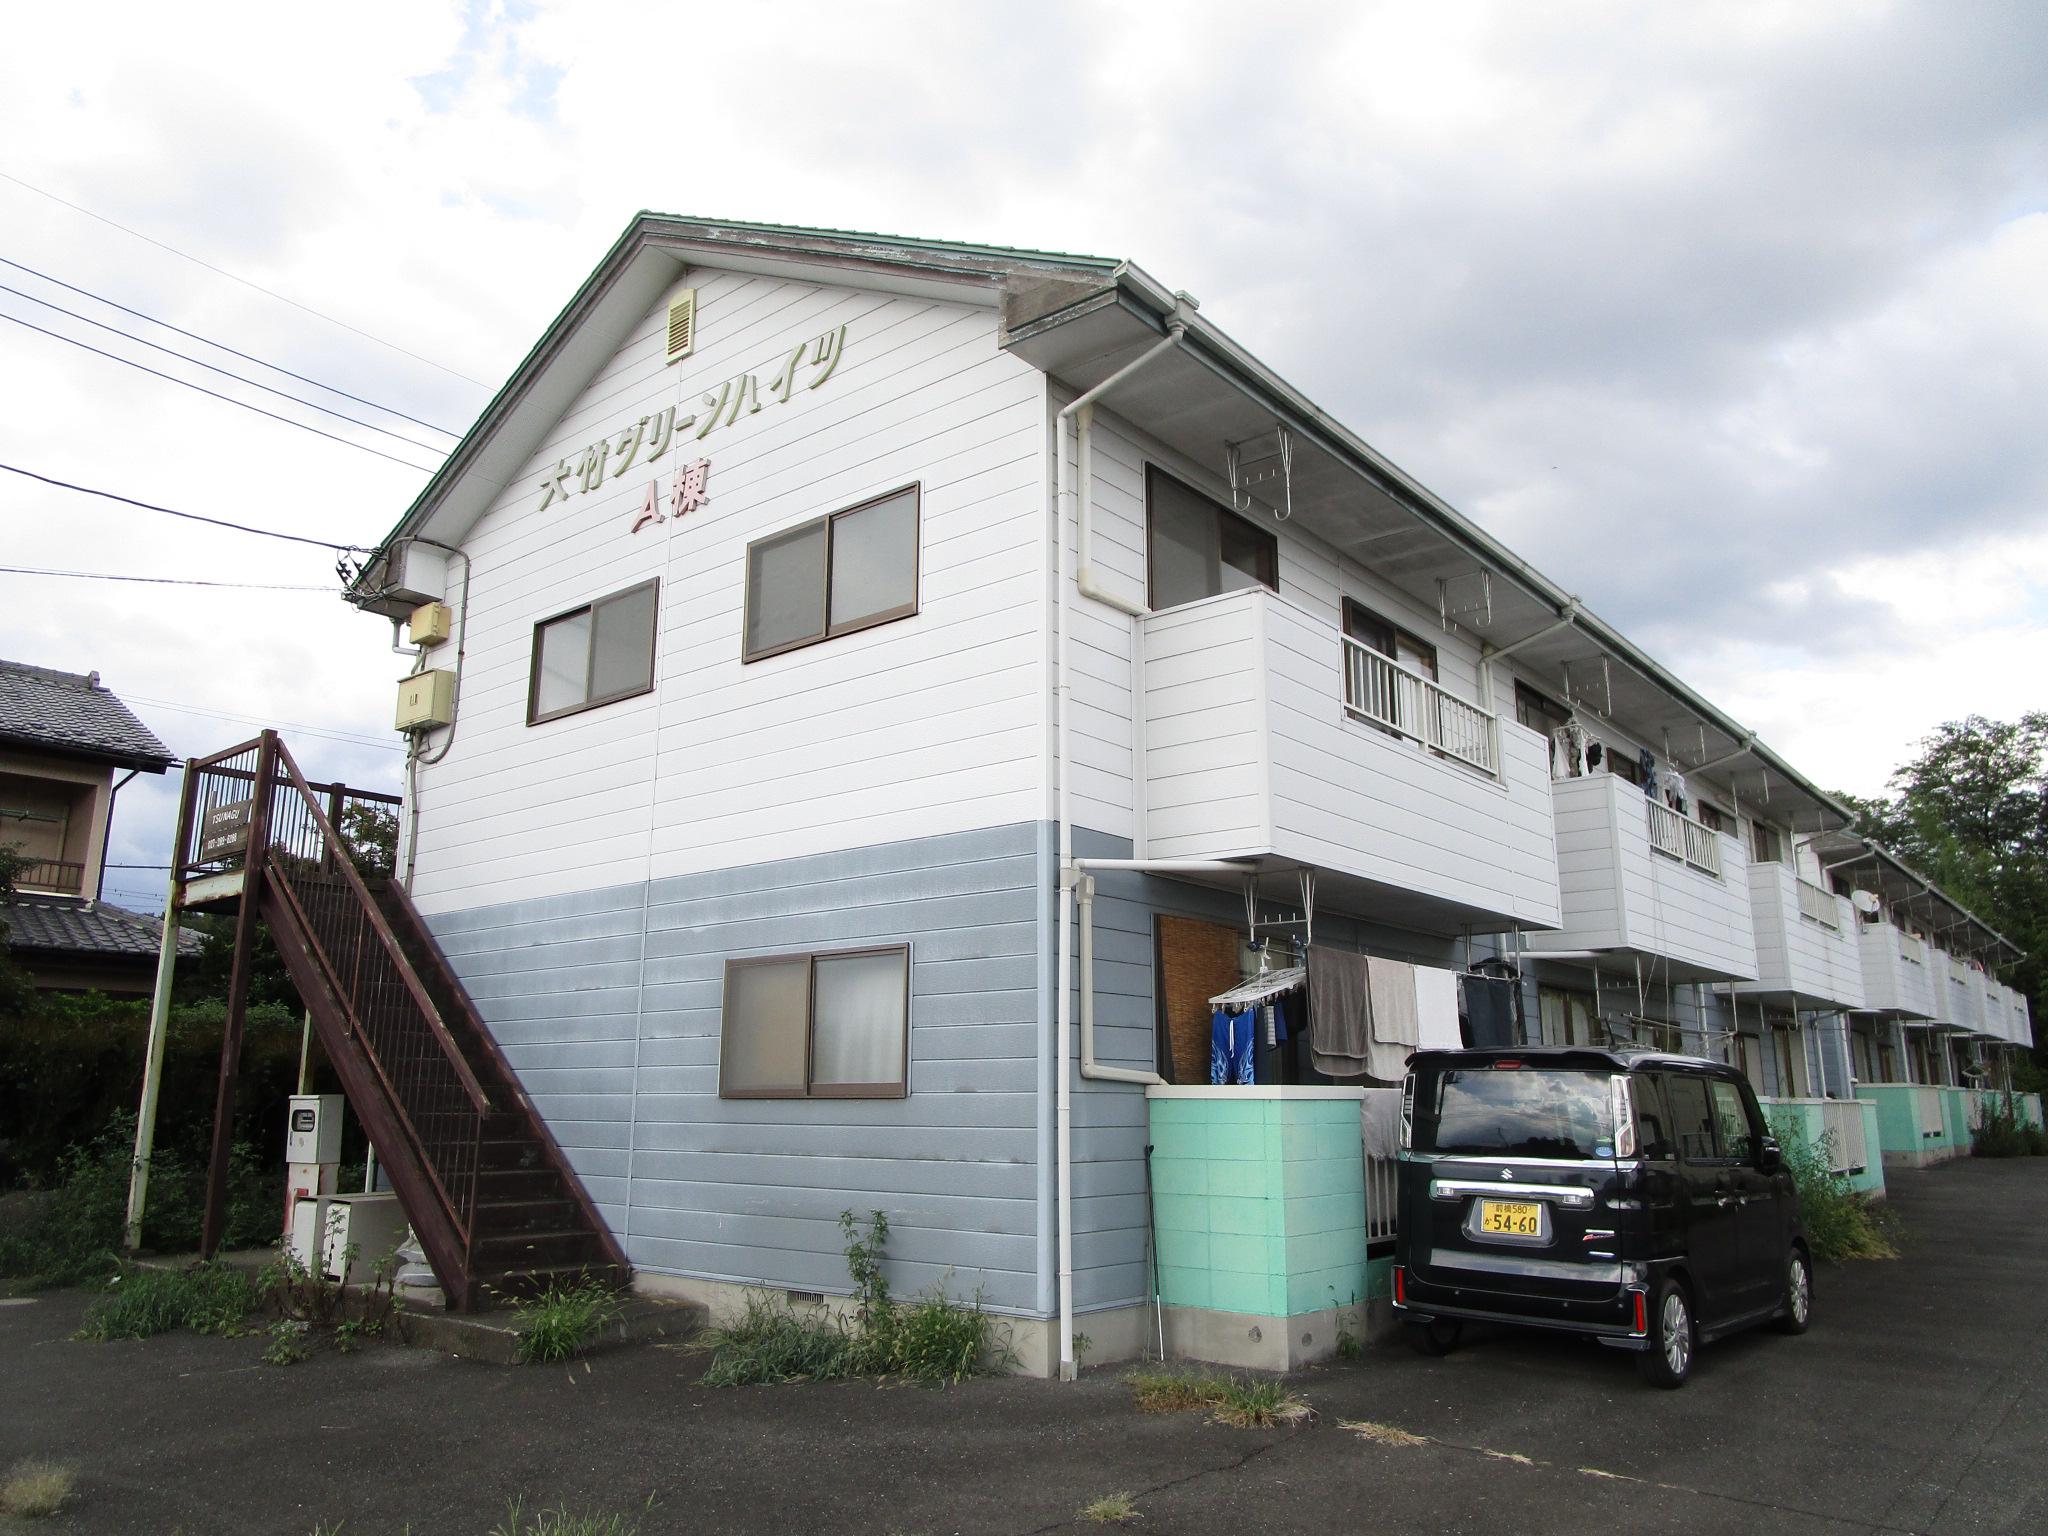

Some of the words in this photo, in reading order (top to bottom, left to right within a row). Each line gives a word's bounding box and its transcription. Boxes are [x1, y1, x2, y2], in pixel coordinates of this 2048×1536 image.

[538, 323, 847, 512] 大竹グリーンハイツ
[631, 457, 712, 534] A棟
[212, 809, 241, 825] TSUNAGU
